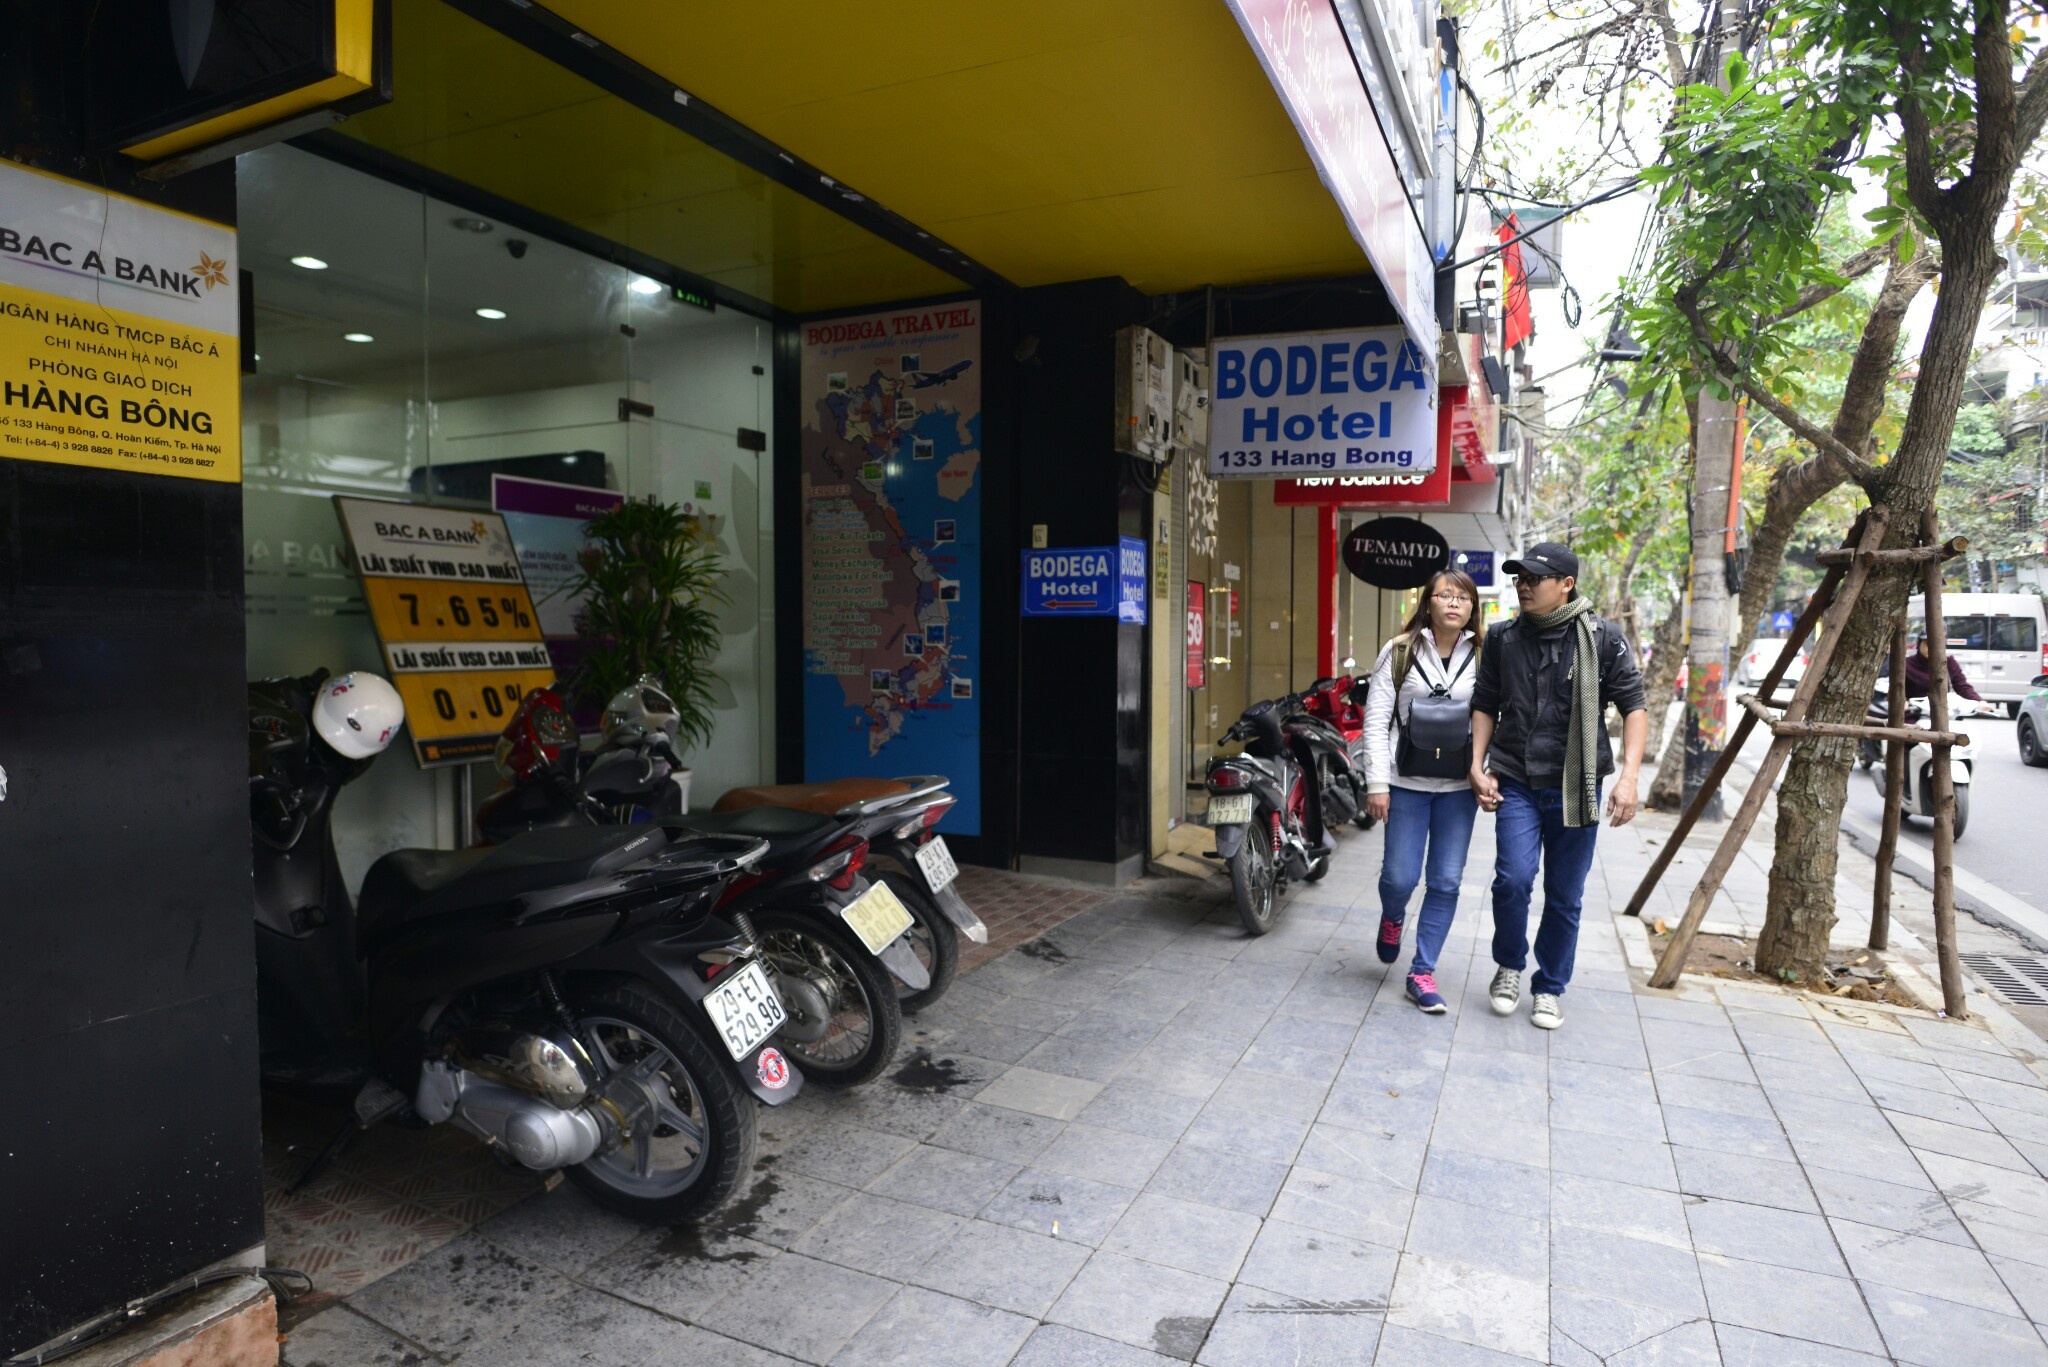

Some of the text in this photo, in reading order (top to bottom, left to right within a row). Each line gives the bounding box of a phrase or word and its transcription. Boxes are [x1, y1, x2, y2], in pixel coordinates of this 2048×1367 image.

[0, 227, 201, 298] BAC A BANK
[56, 312, 109, 335] HÀNG
[115, 325, 165, 345] TMCP
[170, 334, 203, 356] BẮC
[807, 308, 976, 346] BODEGA TRAVEL
[45, 335, 178, 370] CHI NHÁNH HÀ NỘI
[29, 357, 192, 397] PHÒNG GIAO DỊCH
[1217, 339, 1426, 400] BODEGA
[4, 379, 213, 435] HÀNG BÔNG
[1242, 401, 1392, 443] Hotel
[13, 418, 33, 429] 133
[36, 421, 65, 434] Hàng
[102, 430, 113, 440] Q.
[116, 432, 142, 443] Hoàn
[174, 440, 189, 451] Tp.
[191, 442, 204, 452] Hà
[5, 434, 23, 444] Tel:
[25, 437, 60, 450] (+84-4)
[62, 442, 69, 450] 3
[71, 443, 89, 452] 928
[118, 448, 138, 458] Fax:
[171, 455, 177, 463] 3
[179, 456, 194, 465] 928
[1219, 448, 1413, 468] 133 Hang Bong
[807, 486, 850, 496] SERVICES
[374, 521, 480, 544] BAC A BANK
[812, 533, 832, 541] Train
[855, 531, 885, 539] Tickets
[831, 545, 864, 554] Service
[1353, 537, 1441, 559] TENAMYD
[389, 554, 426, 574] SUẤT
[458, 563, 485, 578] CAO
[487, 562, 519, 580] NHẤT
[812, 559, 884, 569] Money Exchange
[1030, 555, 1109, 578] BODEGA
[1121, 548, 1145, 577] BODEGA
[1376, 557, 1412, 568] CANADA
[1467, 563, 1490, 574] SPA
[812, 571, 893, 581] Motorbike For Rent
[843, 585, 872, 594] Airport
[1041, 581, 1098, 596] Hotel
[1123, 581, 1144, 603] Hotel
[848, 625, 880, 635] Pagoda
[420, 646, 456, 667] SUẤT
[459, 651, 487, 667] USD
[488, 650, 515, 666] CAO
[517, 646, 549, 665] NHẤT
[624, 836, 648, 852] HONDA
[725, 995, 782, 1054] 529.98
